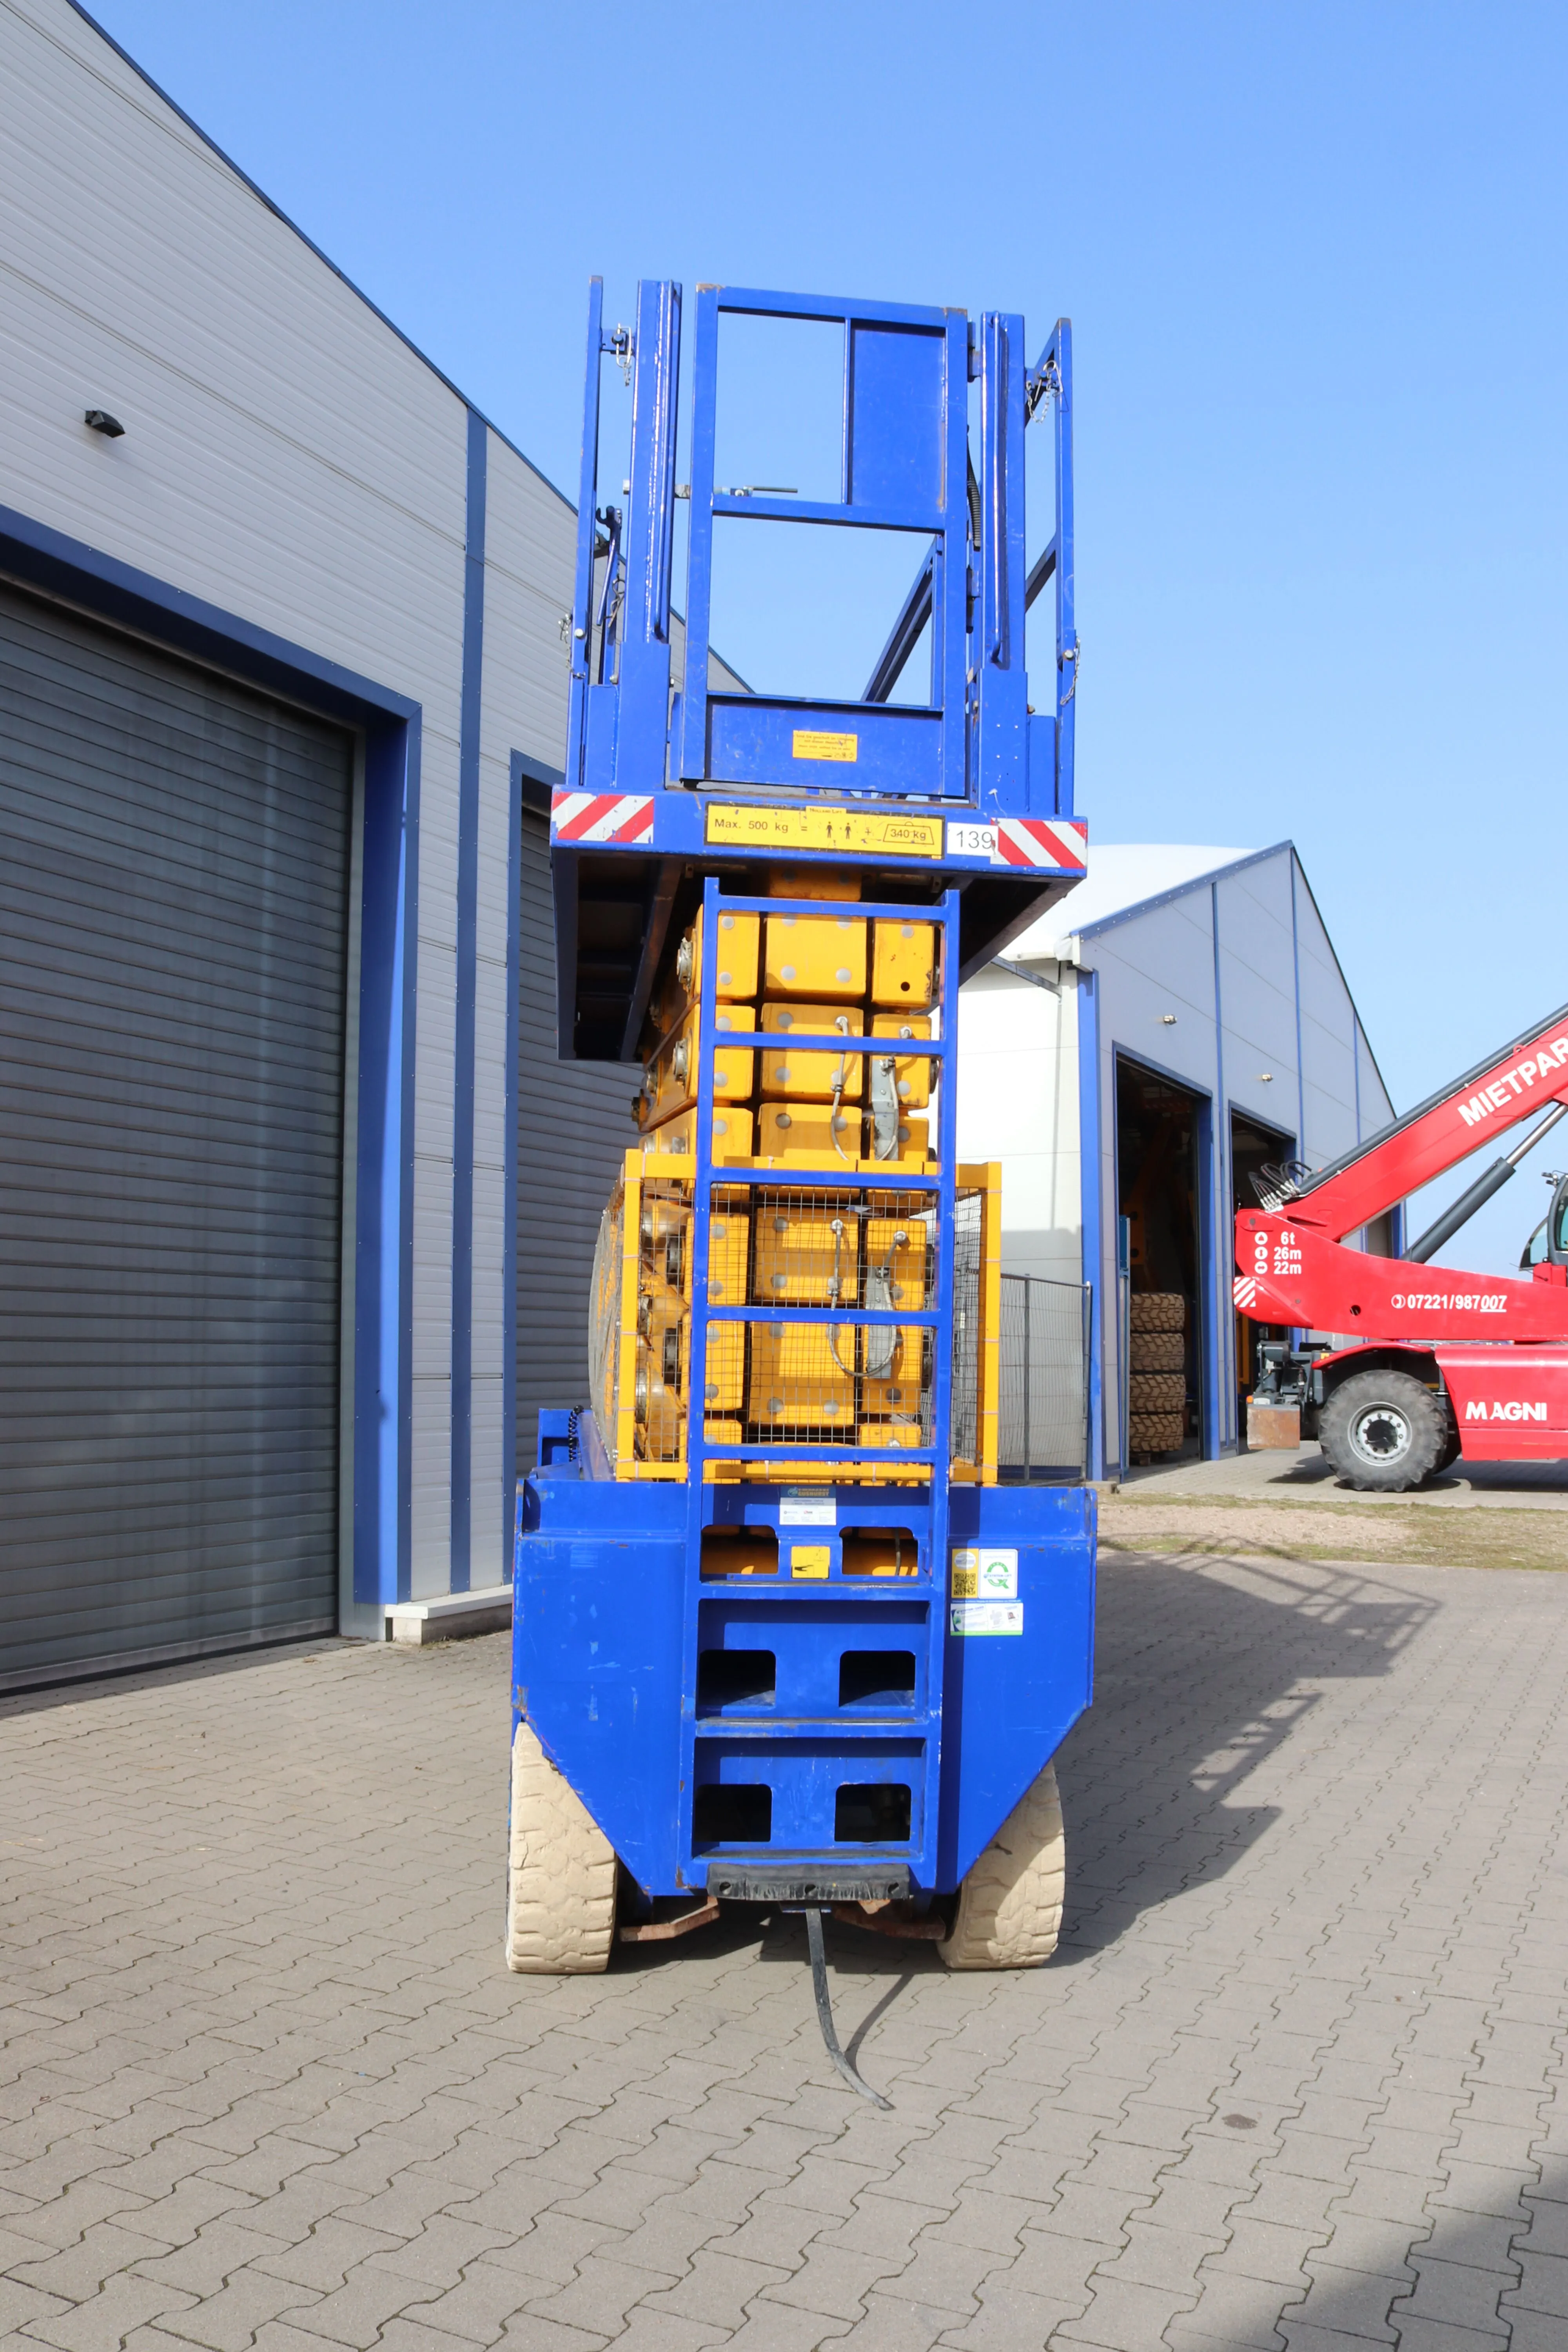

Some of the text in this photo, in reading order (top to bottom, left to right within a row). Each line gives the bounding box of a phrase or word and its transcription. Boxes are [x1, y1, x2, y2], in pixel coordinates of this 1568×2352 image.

[714, 818, 741, 829] Max.
[748, 820, 768, 830] 500
[775, 822, 788, 833] kg
[890, 829, 909, 838] 340
[913, 830, 926, 841] kg
[956, 830, 993, 849] 139
[1457, 1033, 1568, 1127] MIETPAR
[1281, 1231, 1296, 1245] 6t
[1273, 1246, 1302, 1260] 26m
[1273, 1261, 1302, 1274] 22m
[1407, 1294, 1508, 1310] 07221/987007
[1465, 1401, 1547, 1421] MAGNI
